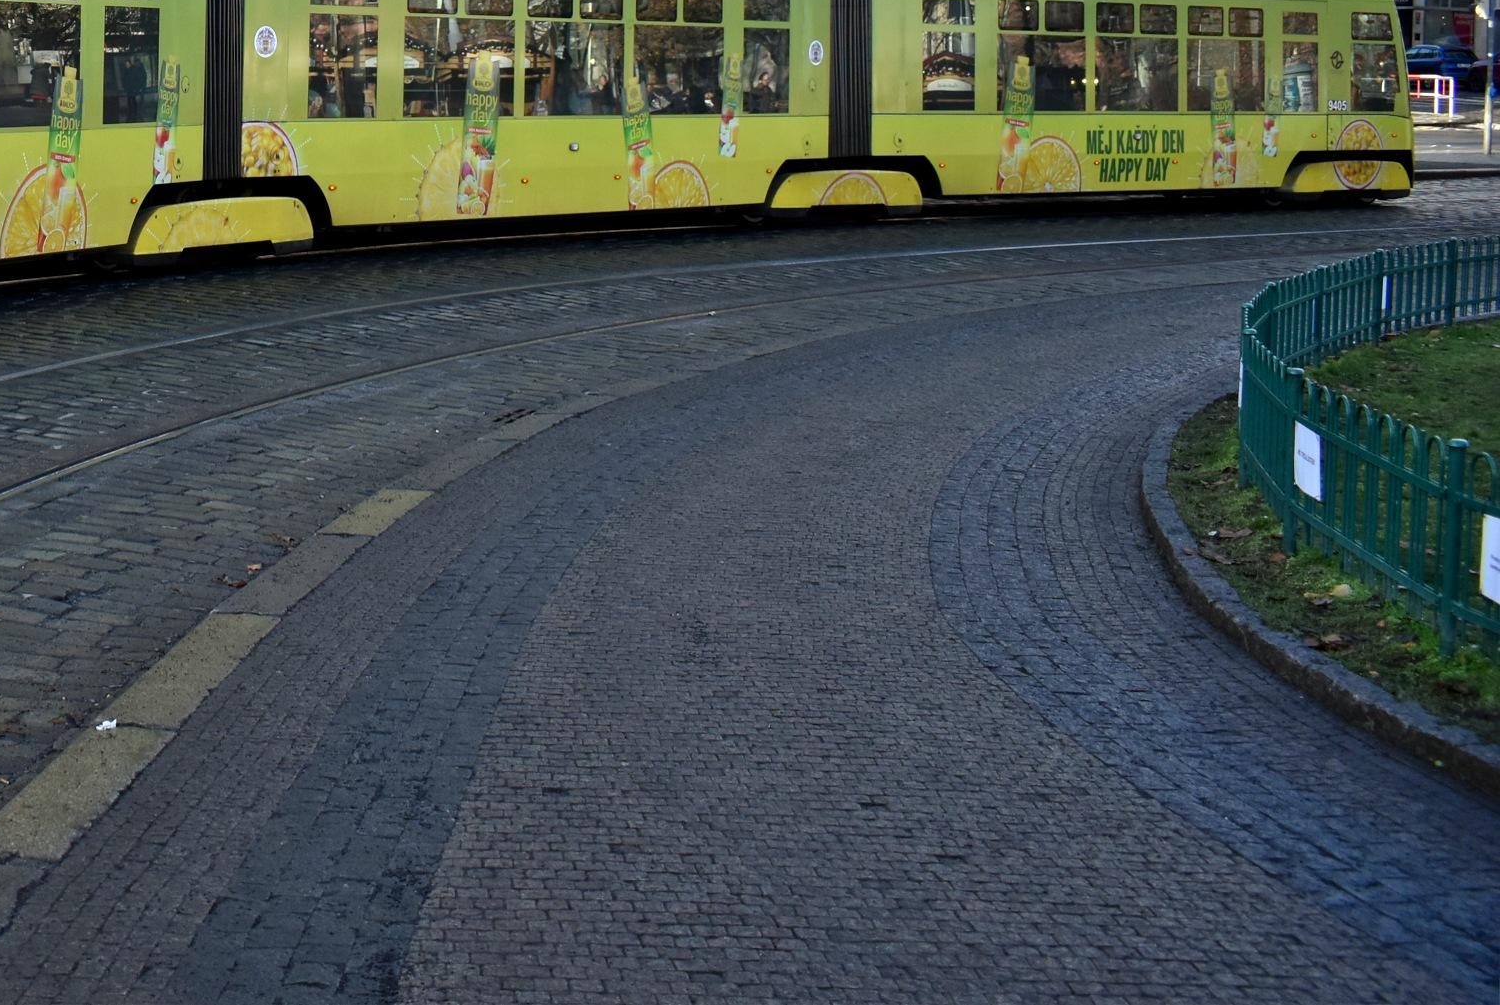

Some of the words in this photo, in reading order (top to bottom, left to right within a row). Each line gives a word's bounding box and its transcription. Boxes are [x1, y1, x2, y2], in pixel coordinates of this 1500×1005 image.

[465, 88, 499, 113] happy
[1328, 99, 1348, 112] 9405
[51, 109, 81, 137] happy
[471, 106, 492, 127] day
[54, 130, 74, 154] day
[1086, 124, 1113, 155] MĚJ
[1116, 124, 1158, 155] KAŽDÝ
[1161, 129, 1185, 154] DEN
[1099, 157, 1143, 183] HAPPY
[1145, 157, 1171, 182] DAY
